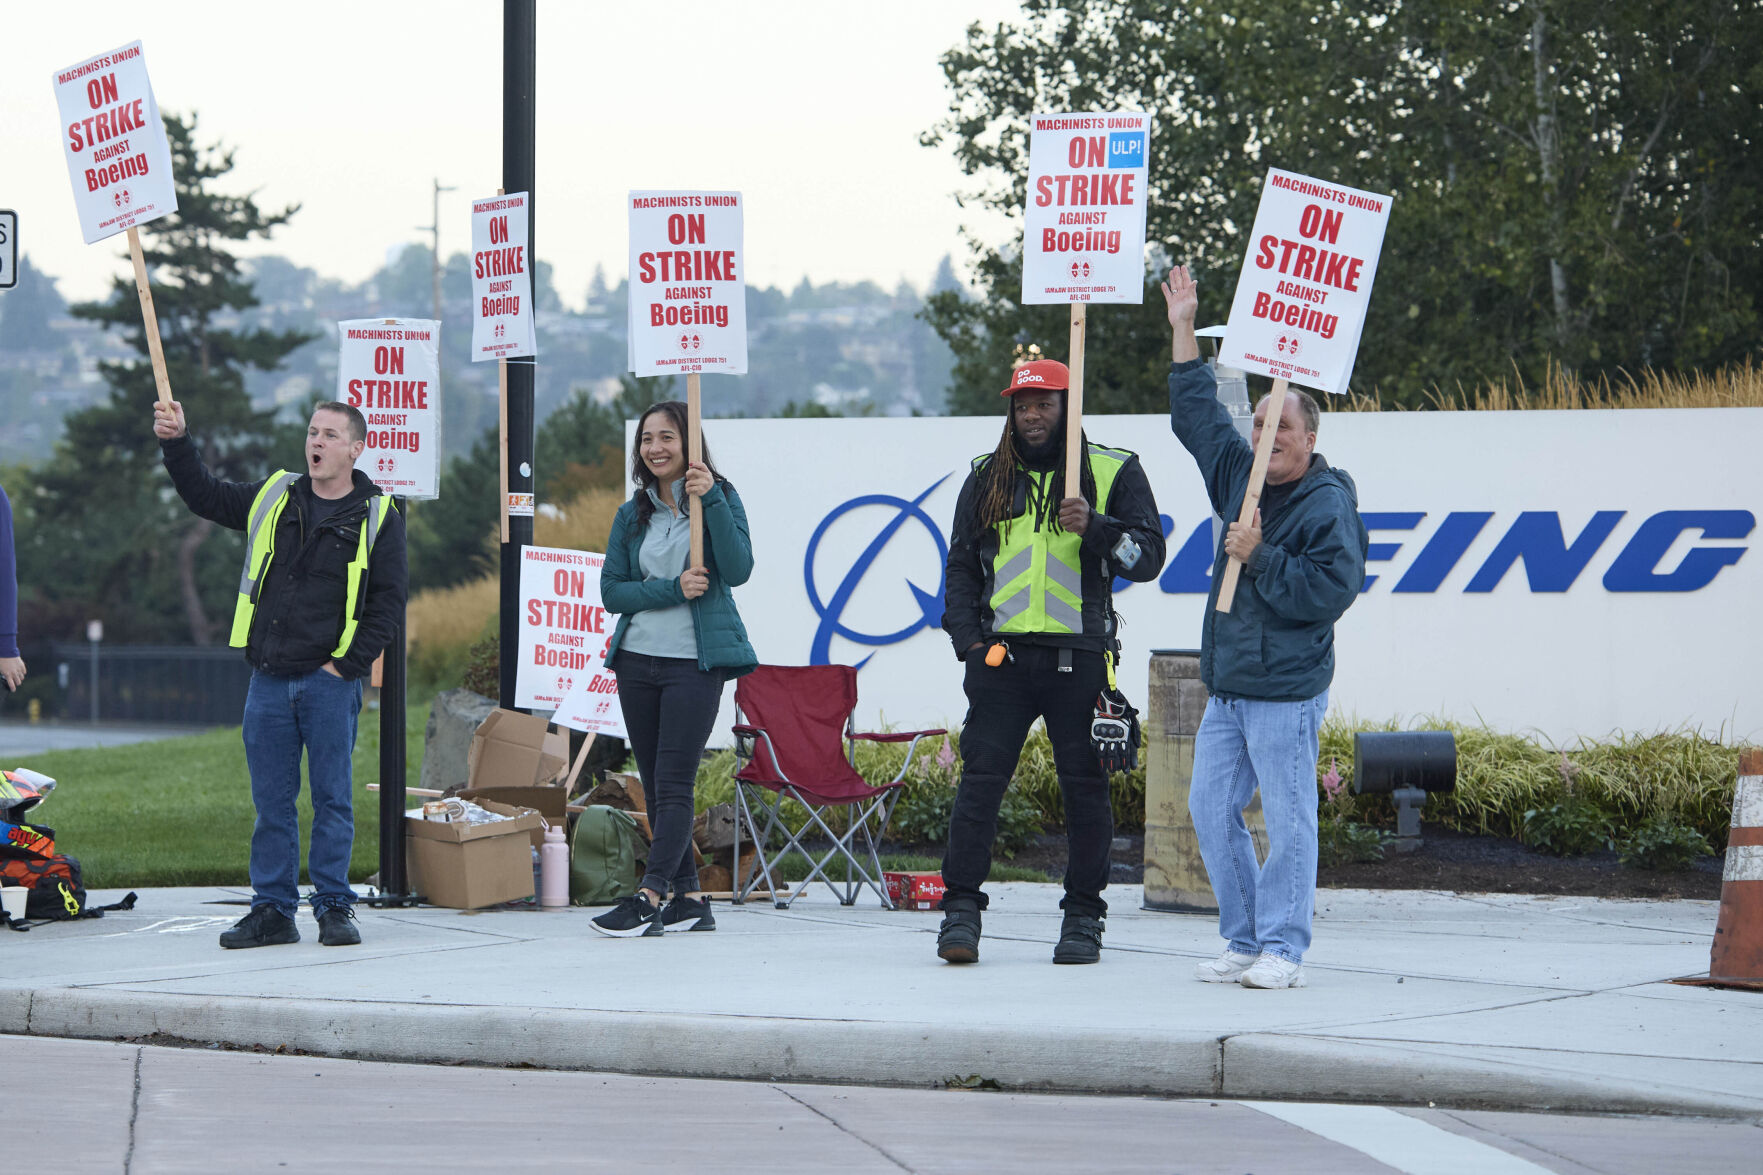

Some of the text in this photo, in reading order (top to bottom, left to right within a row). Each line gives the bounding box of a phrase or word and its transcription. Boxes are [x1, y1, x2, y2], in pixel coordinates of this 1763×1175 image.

[58, 46, 140, 85] MACHINISTS UNION
[87, 72, 118, 110] ON
[68, 99, 146, 152] STRIKE
[1036, 118, 1142, 130] MACHINISTS UNION
[94, 140, 130, 163] AGAINST
[1068, 136, 1106, 168] ON
[1112, 140, 1140, 155] ULP!
[85, 152, 149, 192] Boeing
[633, 196, 737, 209] MACHINISTS UNION
[1036, 174, 1135, 207] STRIKE
[1272, 175, 1383, 214] MACHINISTS UNION
[474, 198, 524, 213] MACHINISTS UNION
[1059, 212, 1107, 225] AGAINST
[490, 216, 509, 244] ON
[668, 213, 705, 245] ON
[1299, 204, 1344, 245] ON
[1042, 227, 1121, 254] Boeing
[475, 246, 524, 279] STRIKE
[639, 251, 736, 284] STRIKE
[1256, 234, 1364, 292] STRIKE
[489, 280, 512, 294] AGAINST
[665, 287, 712, 300] AGAINST
[1276, 280, 1328, 305] AGAINST
[482, 294, 520, 318] Boeing
[650, 301, 728, 328] Boeing
[1252, 291, 1339, 340] Boeing
[348, 329, 430, 340] MACHINISTS UNION
[374, 346, 404, 375] ON
[1018, 369, 1030, 378] DO
[1269, 359, 1293, 370] DISTRICT
[1294, 365, 1311, 376] LODGE
[1269, 368, 1292, 378] AFL-CIO
[1017, 375, 1044, 384] GOOD.
[348, 379, 428, 409] STRIKE
[368, 414, 407, 426] AGAINST
[366, 428, 420, 453] oeing
[526, 550, 604, 568] MACHINISTS UNIO
[1112, 510, 1756, 593] EING
[554, 569, 585, 598] ON
[528, 598, 605, 634] STRIKE
[548, 633, 584, 648] AGAINST
[587, 674, 618, 694] Boe
[8, 827, 39, 846] agv
